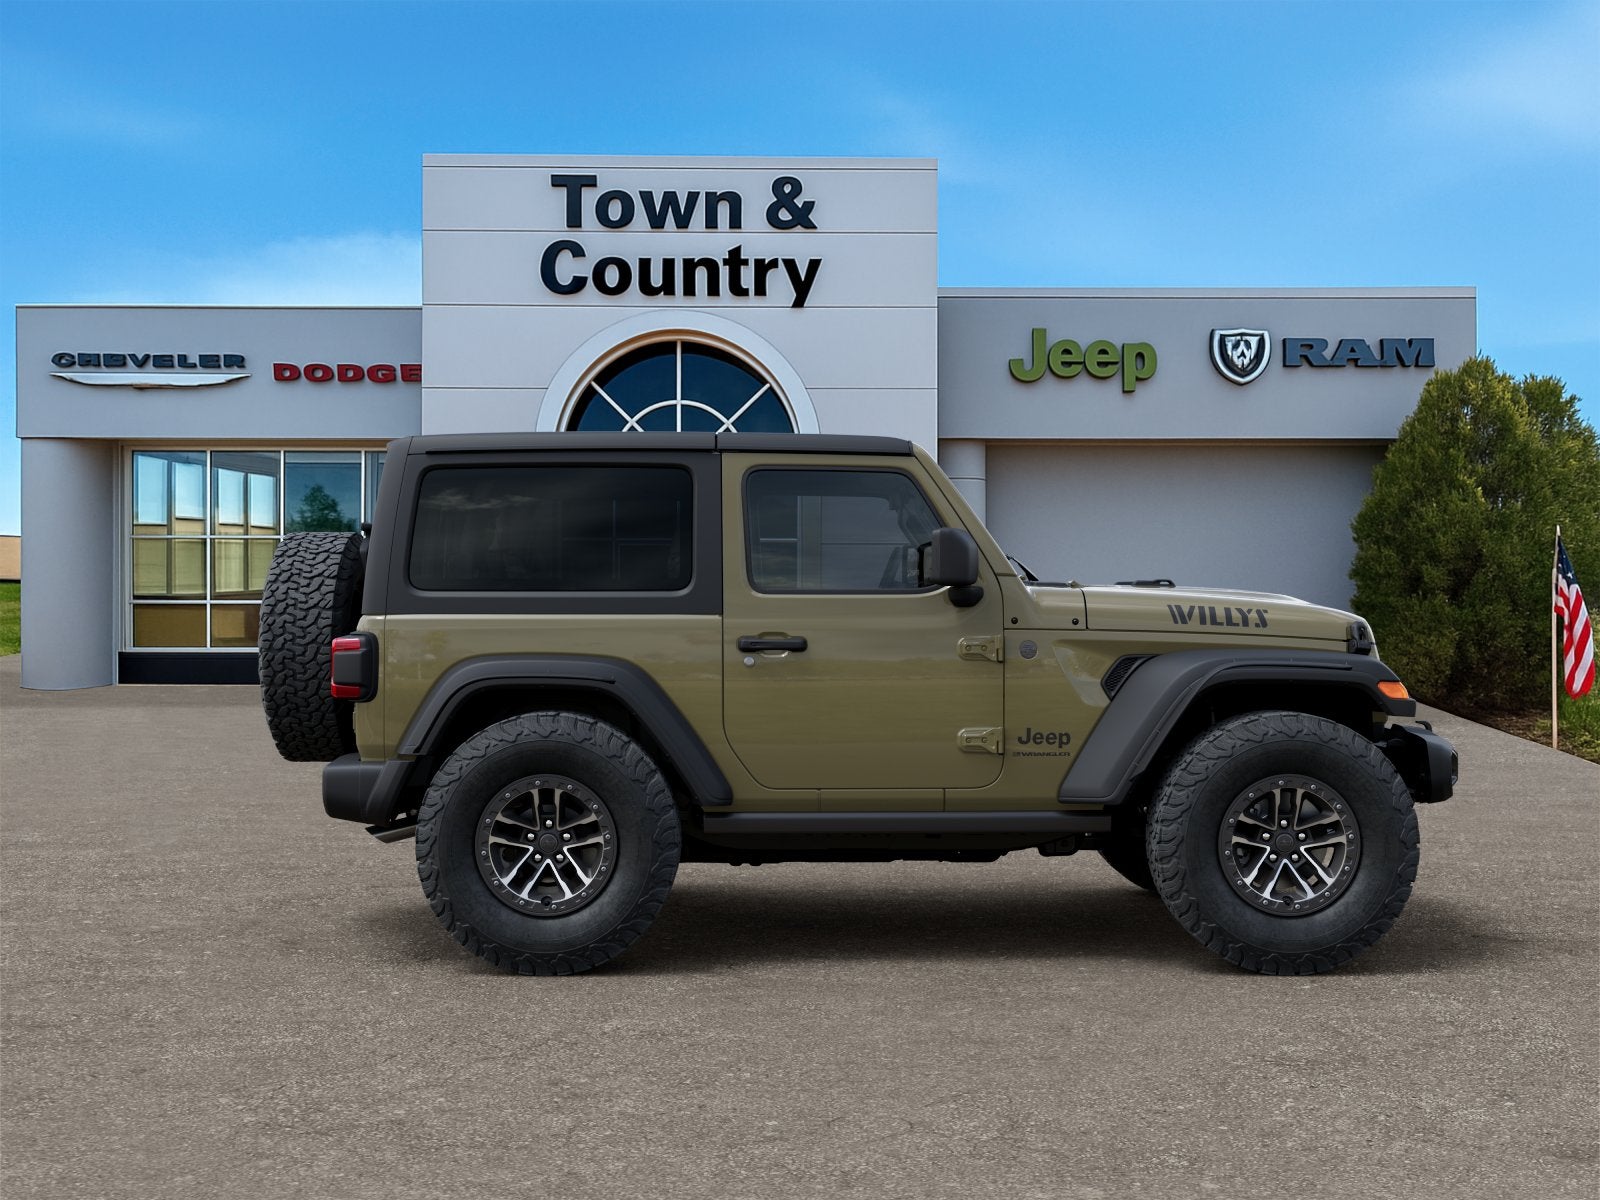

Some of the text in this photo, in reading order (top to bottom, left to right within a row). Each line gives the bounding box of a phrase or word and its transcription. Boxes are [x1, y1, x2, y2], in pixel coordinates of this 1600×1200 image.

[550, 174, 818, 230] Town &
[540, 240, 822, 308] Country
[1009, 328, 1157, 392] Jeep
[1282, 337, 1435, 368] RAM
[273, 362, 422, 383] DODGE
[1167, 604, 1268, 628] WILLYS
[1017, 727, 1071, 749] Jeep
